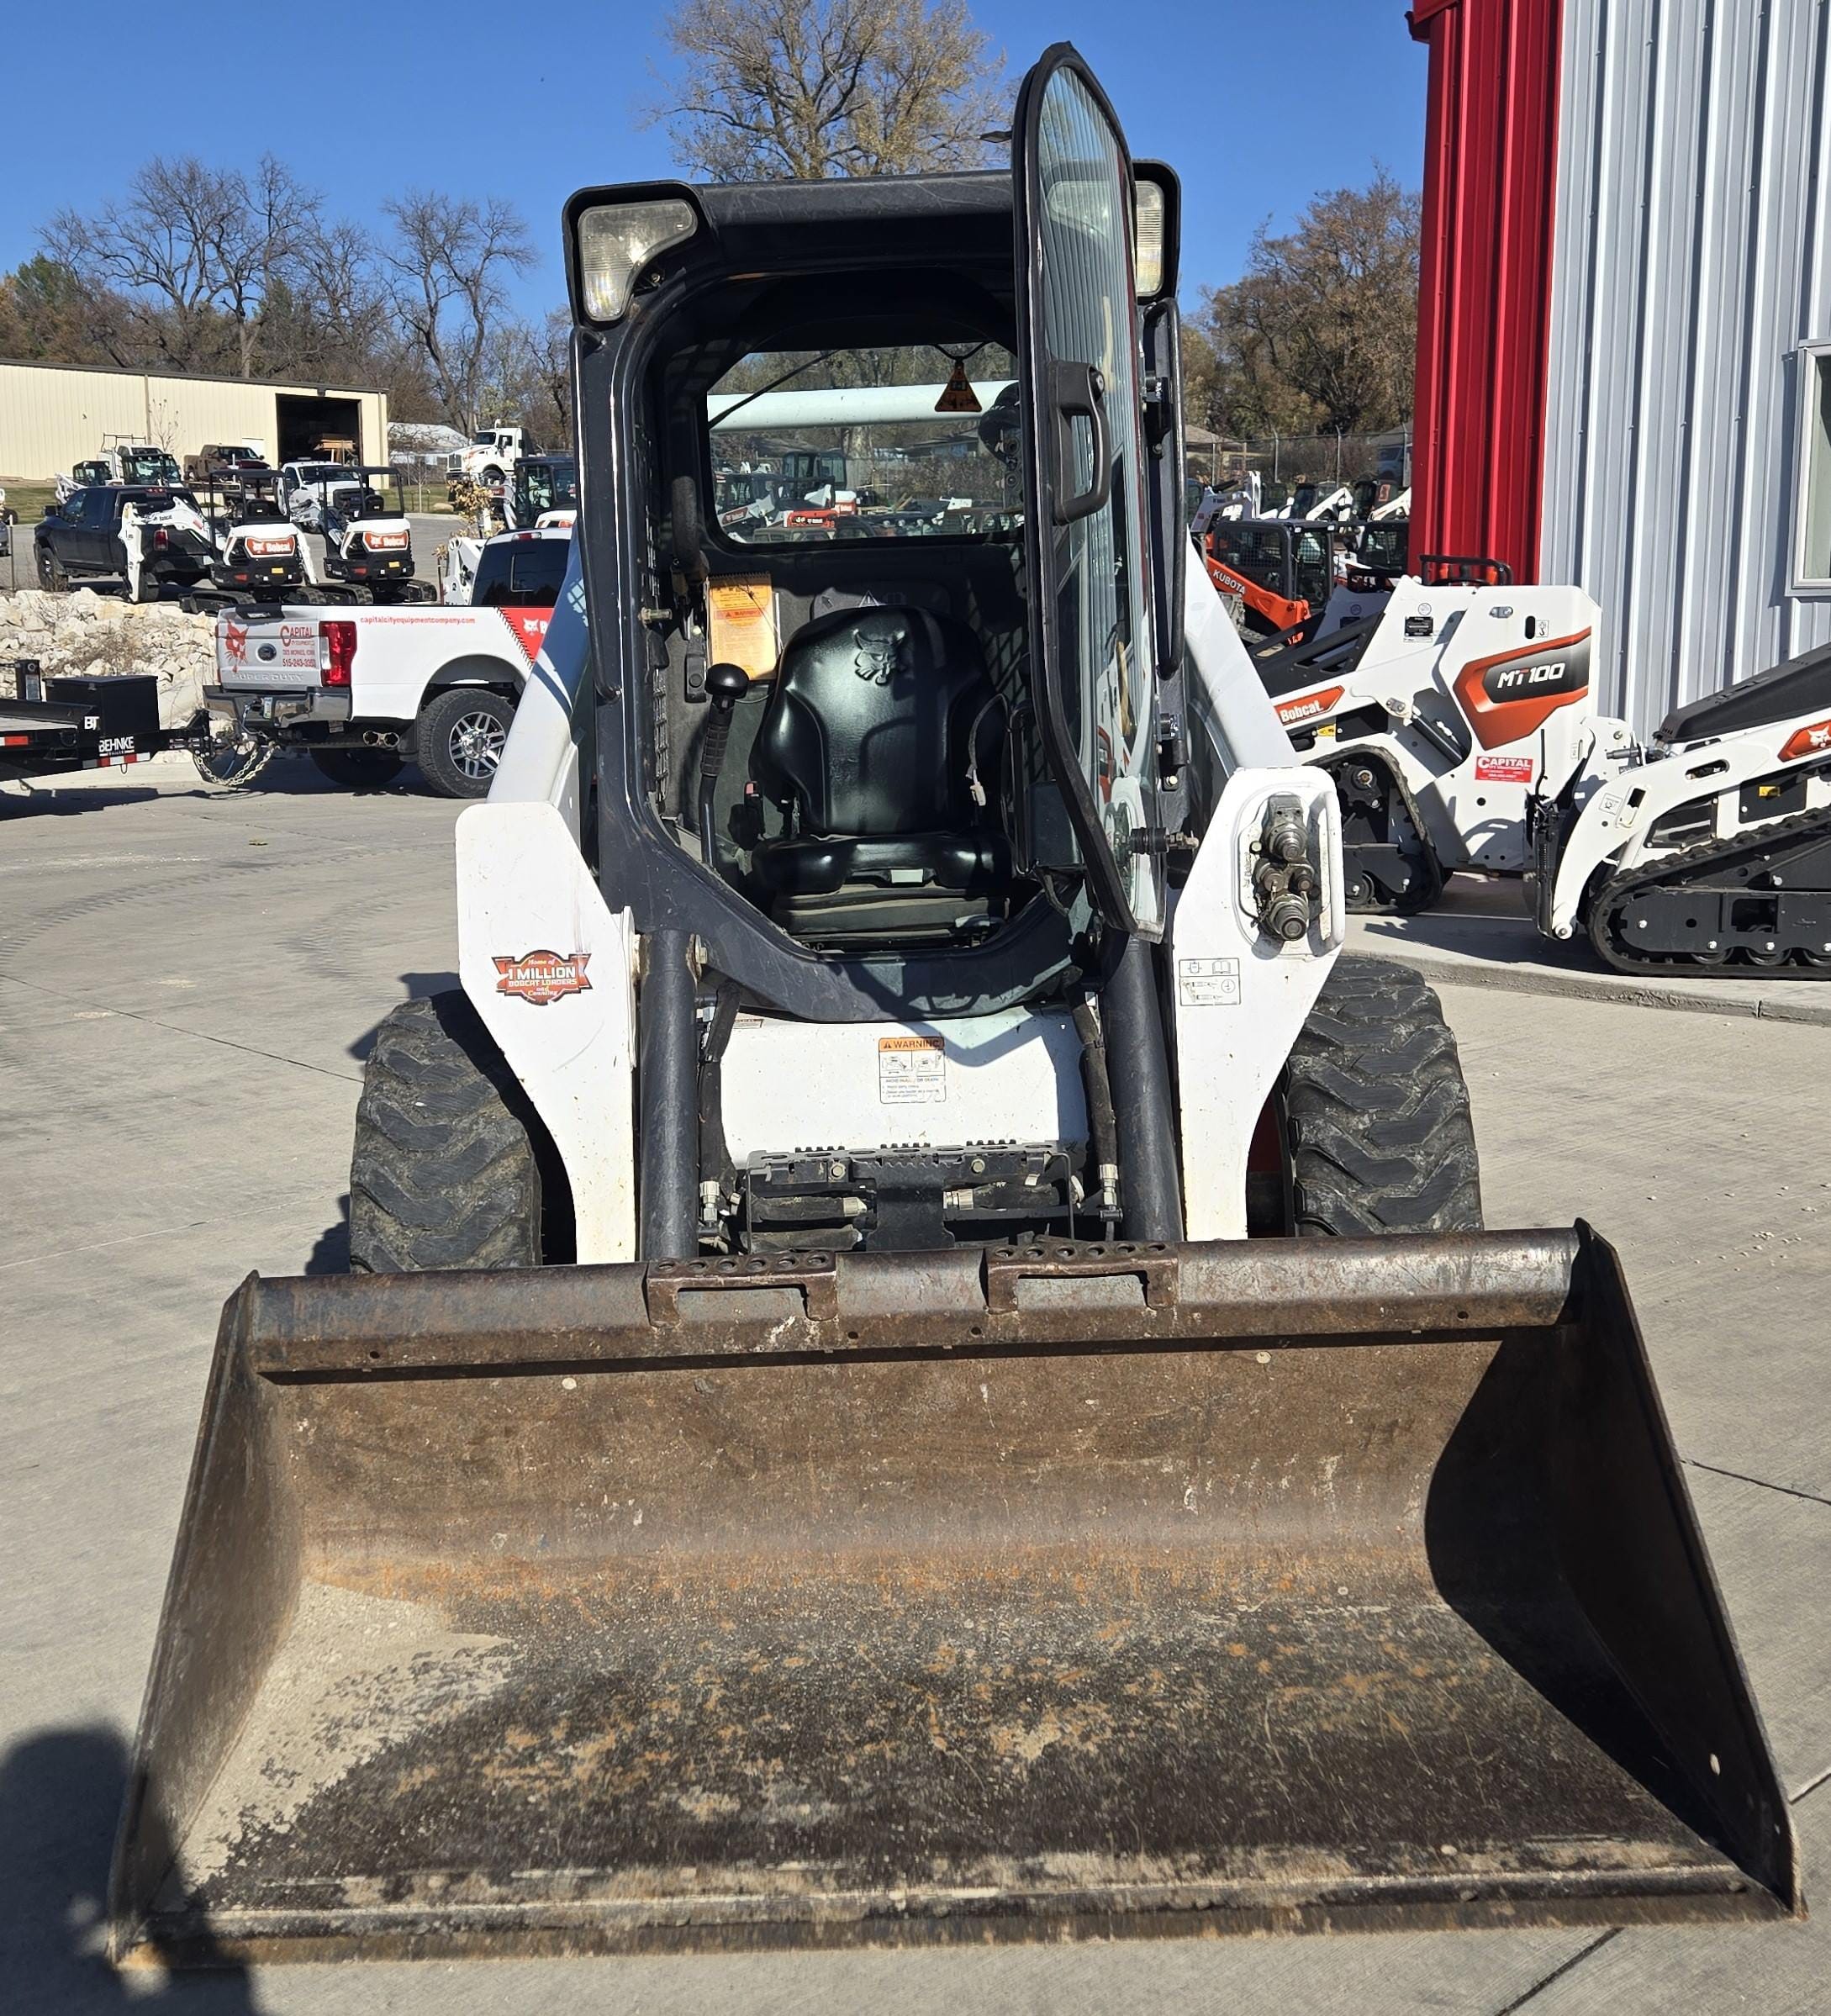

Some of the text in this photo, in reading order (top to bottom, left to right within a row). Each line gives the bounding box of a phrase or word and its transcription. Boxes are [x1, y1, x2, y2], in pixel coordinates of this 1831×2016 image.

[266, 541, 291, 552] Bobcat
[1213, 569, 1246, 595] KUBOTA
[360, 615, 476, 625] capitalcityequipmentcompany.com
[280, 625, 313, 646] CAPITAL
[232, 673, 303, 682] SUPER DUTY
[1496, 662, 1566, 689] MT100
[1280, 699, 1324, 723] Bobcat
[84, 716, 100, 730] BT
[98, 736, 135, 753] BEHNKE
[1478, 757, 1531, 769] CAPITAL
[508, 966, 576, 980] 1 MILLION
[541, 978, 578, 986] LOADERS
[893, 1040, 940, 1049] WARNING
